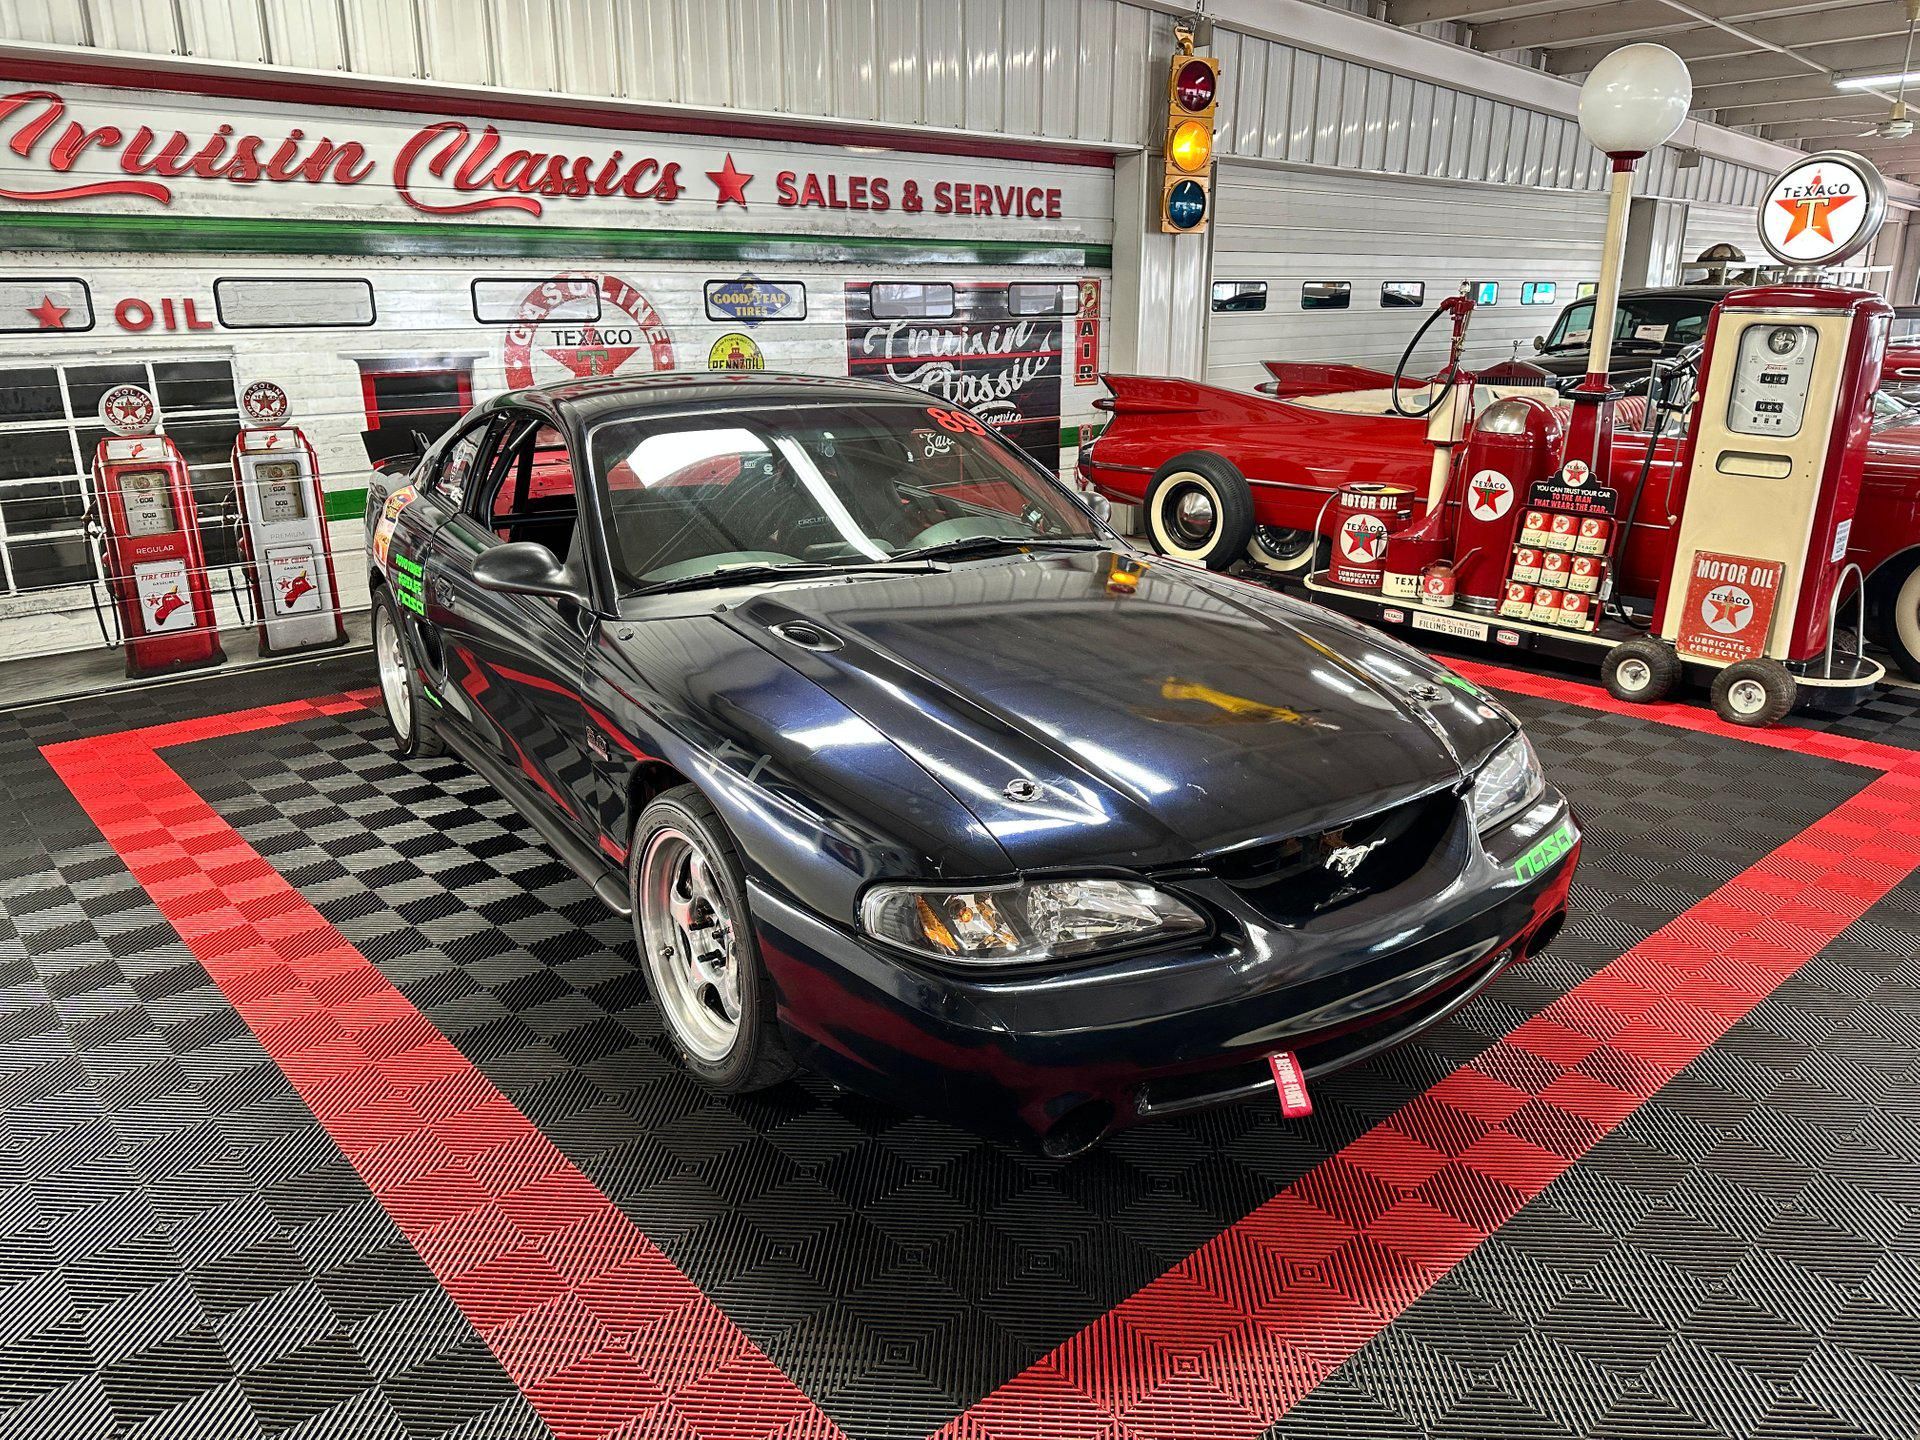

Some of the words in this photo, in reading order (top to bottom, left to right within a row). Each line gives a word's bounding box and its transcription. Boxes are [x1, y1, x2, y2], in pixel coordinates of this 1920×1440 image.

[0, 91, 375, 205] Cruisin
[393, 121, 686, 217] Classics
[776, 171, 890, 211] SALES
[902, 179, 923, 212] &
[934, 181, 1062, 219] SERVICE
[1784, 183, 1850, 198] TEXACO
[114, 298, 213, 331] OIL
[508, 274, 671, 347] GASOLINE
[735, 306, 768, 316] TIRES
[551, 329, 632, 346] TEXACO
[1081, 321, 1094, 379] AIR
[106, 389, 150, 408] GASOLINE
[245, 383, 285, 400] GASOLINE
[926, 407, 986, 436] 89
[1475, 480, 1505, 490] TEXACO
[1563, 487, 1580, 495] TRUST
[1341, 493, 1376, 510] MOTOR
[1379, 496, 1398, 510] OIL
[1534, 498, 1549, 507] THAT
[1550, 500, 1575, 510] WEARS
[1575, 502, 1588, 511] THE
[1552, 492, 1560, 500] TO
[1561, 494, 1574, 502] THE
[1574, 495, 1592, 503] MAN
[271, 531, 305, 539] PREMIUM
[1346, 522, 1384, 532] TEXACO
[136, 545, 175, 554] REGULAR
[1338, 570, 1380, 580] LUBRICATES
[1697, 559, 1748, 585] MOTOR
[1751, 566, 1773, 589] OIL
[1711, 592, 1750, 606] TEXACO
[1419, 620, 1447, 632] FILLING
[1448, 625, 1480, 638] STATION
[1688, 635, 1751, 653] LUBRICATES
[1689, 644, 1747, 660] PERFECTLY
